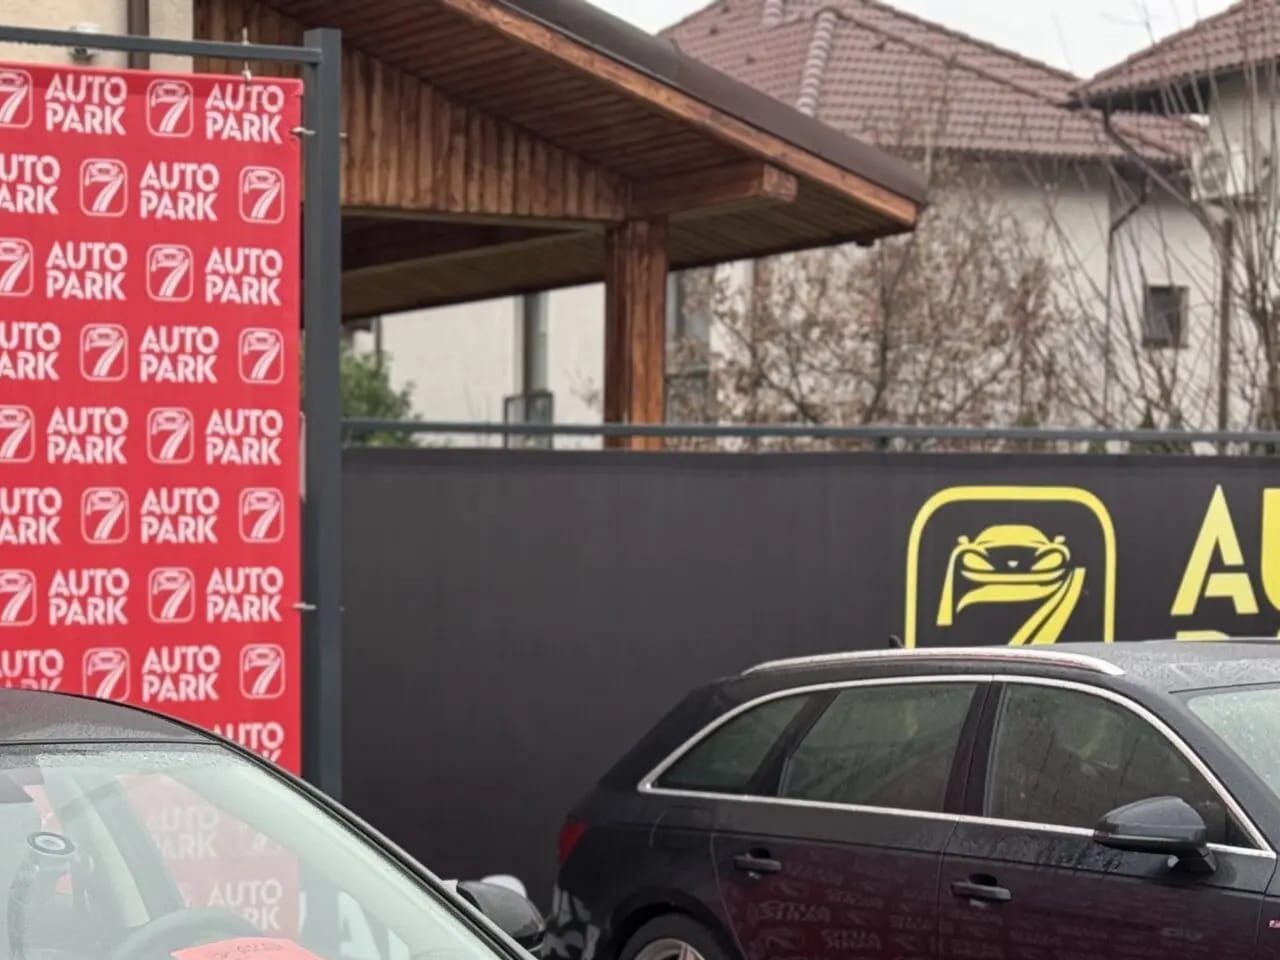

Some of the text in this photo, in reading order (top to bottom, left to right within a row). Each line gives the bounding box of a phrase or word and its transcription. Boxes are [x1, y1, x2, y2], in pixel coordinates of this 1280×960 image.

[46, 75, 126, 105] AUTO
[206, 85, 283, 113] AUTO
[46, 102, 125, 134] PARK
[207, 111, 281, 143] PARK
[140, 163, 219, 191] AUTO
[141, 190, 216, 220] PARK
[47, 242, 127, 271] AUTO
[206, 248, 282, 277] AUTO
[47, 270, 124, 299] PARK
[206, 275, 280, 305] PARK
[141, 327, 218, 354] AUTO
[141, 354, 216, 382] PARK
[48, 407, 128, 435] AUTO
[206, 409, 282, 437] AUTO
[48, 435, 125, 463] PARK
[207, 437, 280, 464] PARK
[141, 488, 219, 514] AUTO
[142, 516, 216, 542] PARK
[50, 569, 129, 596] AUTO
[207, 567, 283, 594] AUTO
[50, 597, 126, 624] PARK
[208, 595, 280, 621] PARK
[143, 646, 220, 673] AUTO
[143, 674, 218, 701] PARK
